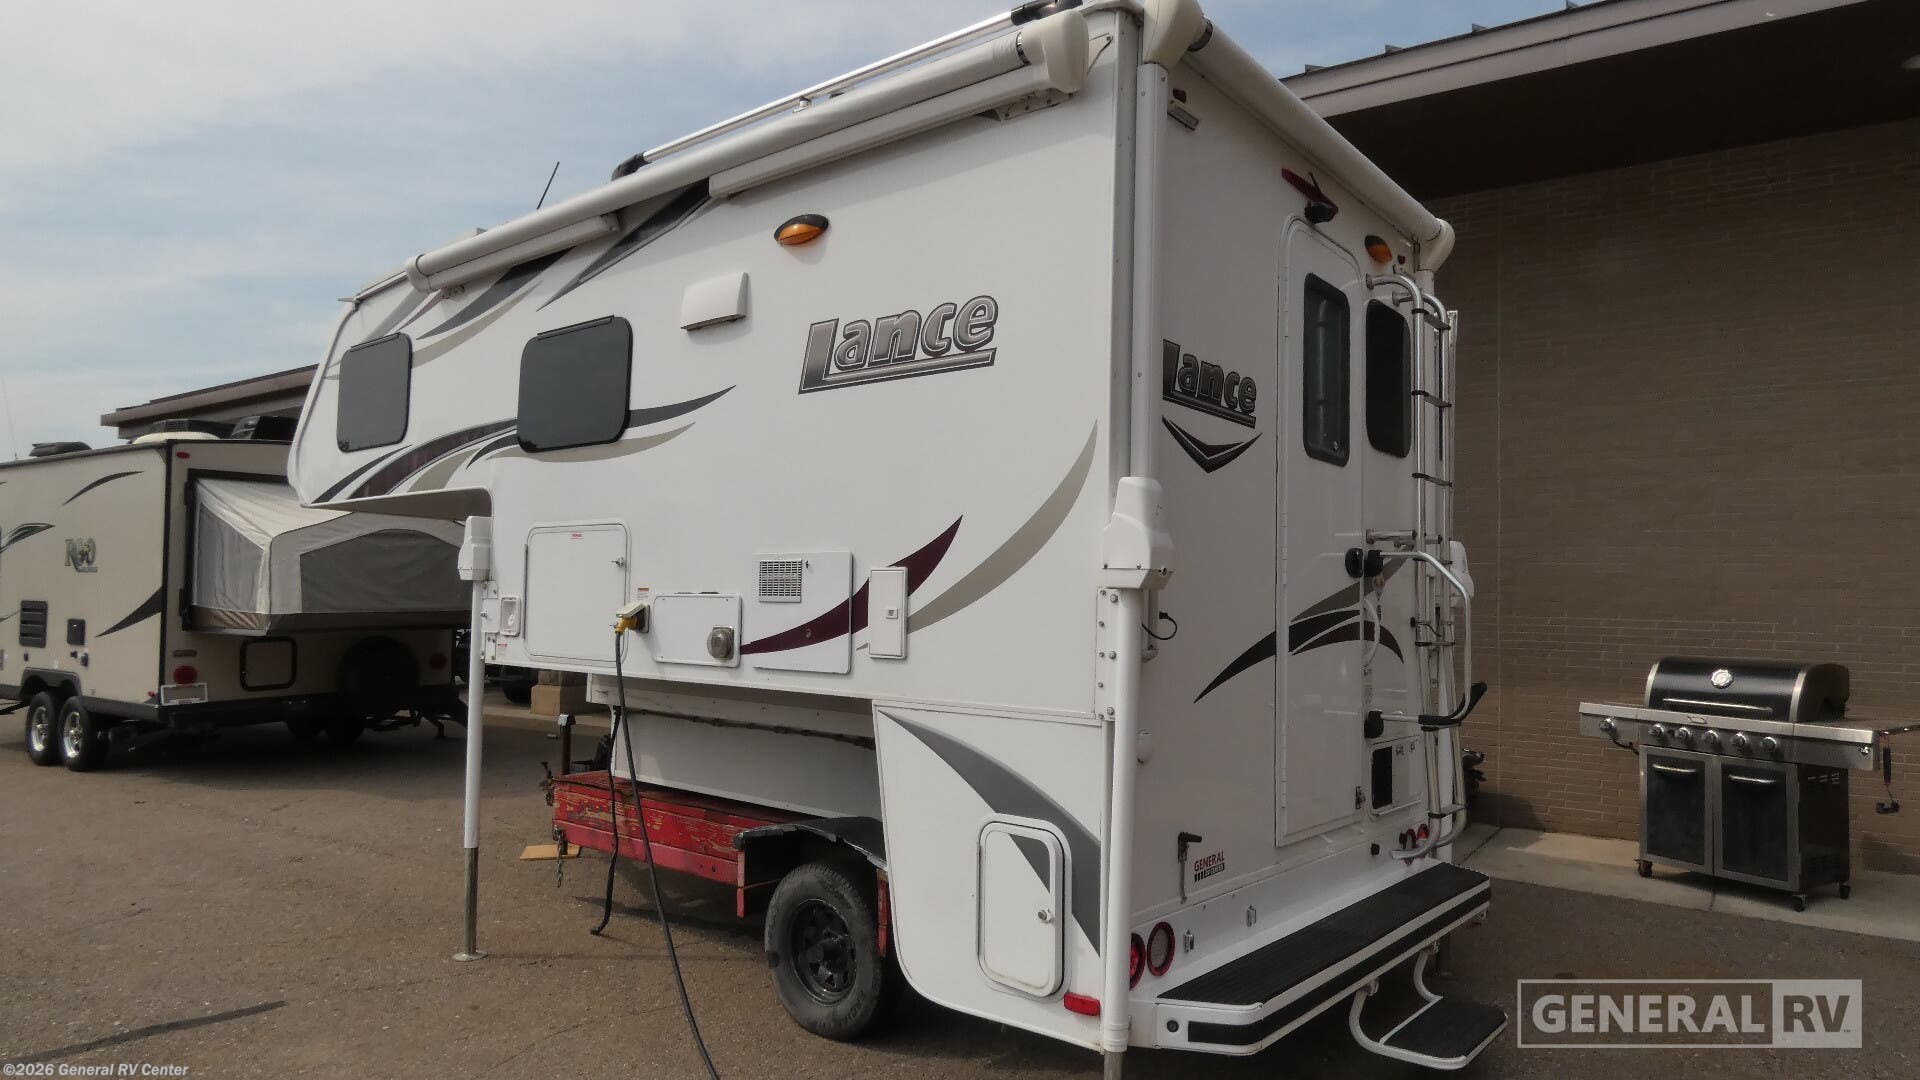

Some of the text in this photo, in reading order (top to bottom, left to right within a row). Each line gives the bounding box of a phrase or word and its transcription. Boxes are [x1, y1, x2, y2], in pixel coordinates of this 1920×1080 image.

[798, 295, 998, 394] Lance
[1162, 338, 1256, 429] Lance
[1194, 851, 1225, 872] GENERAL
